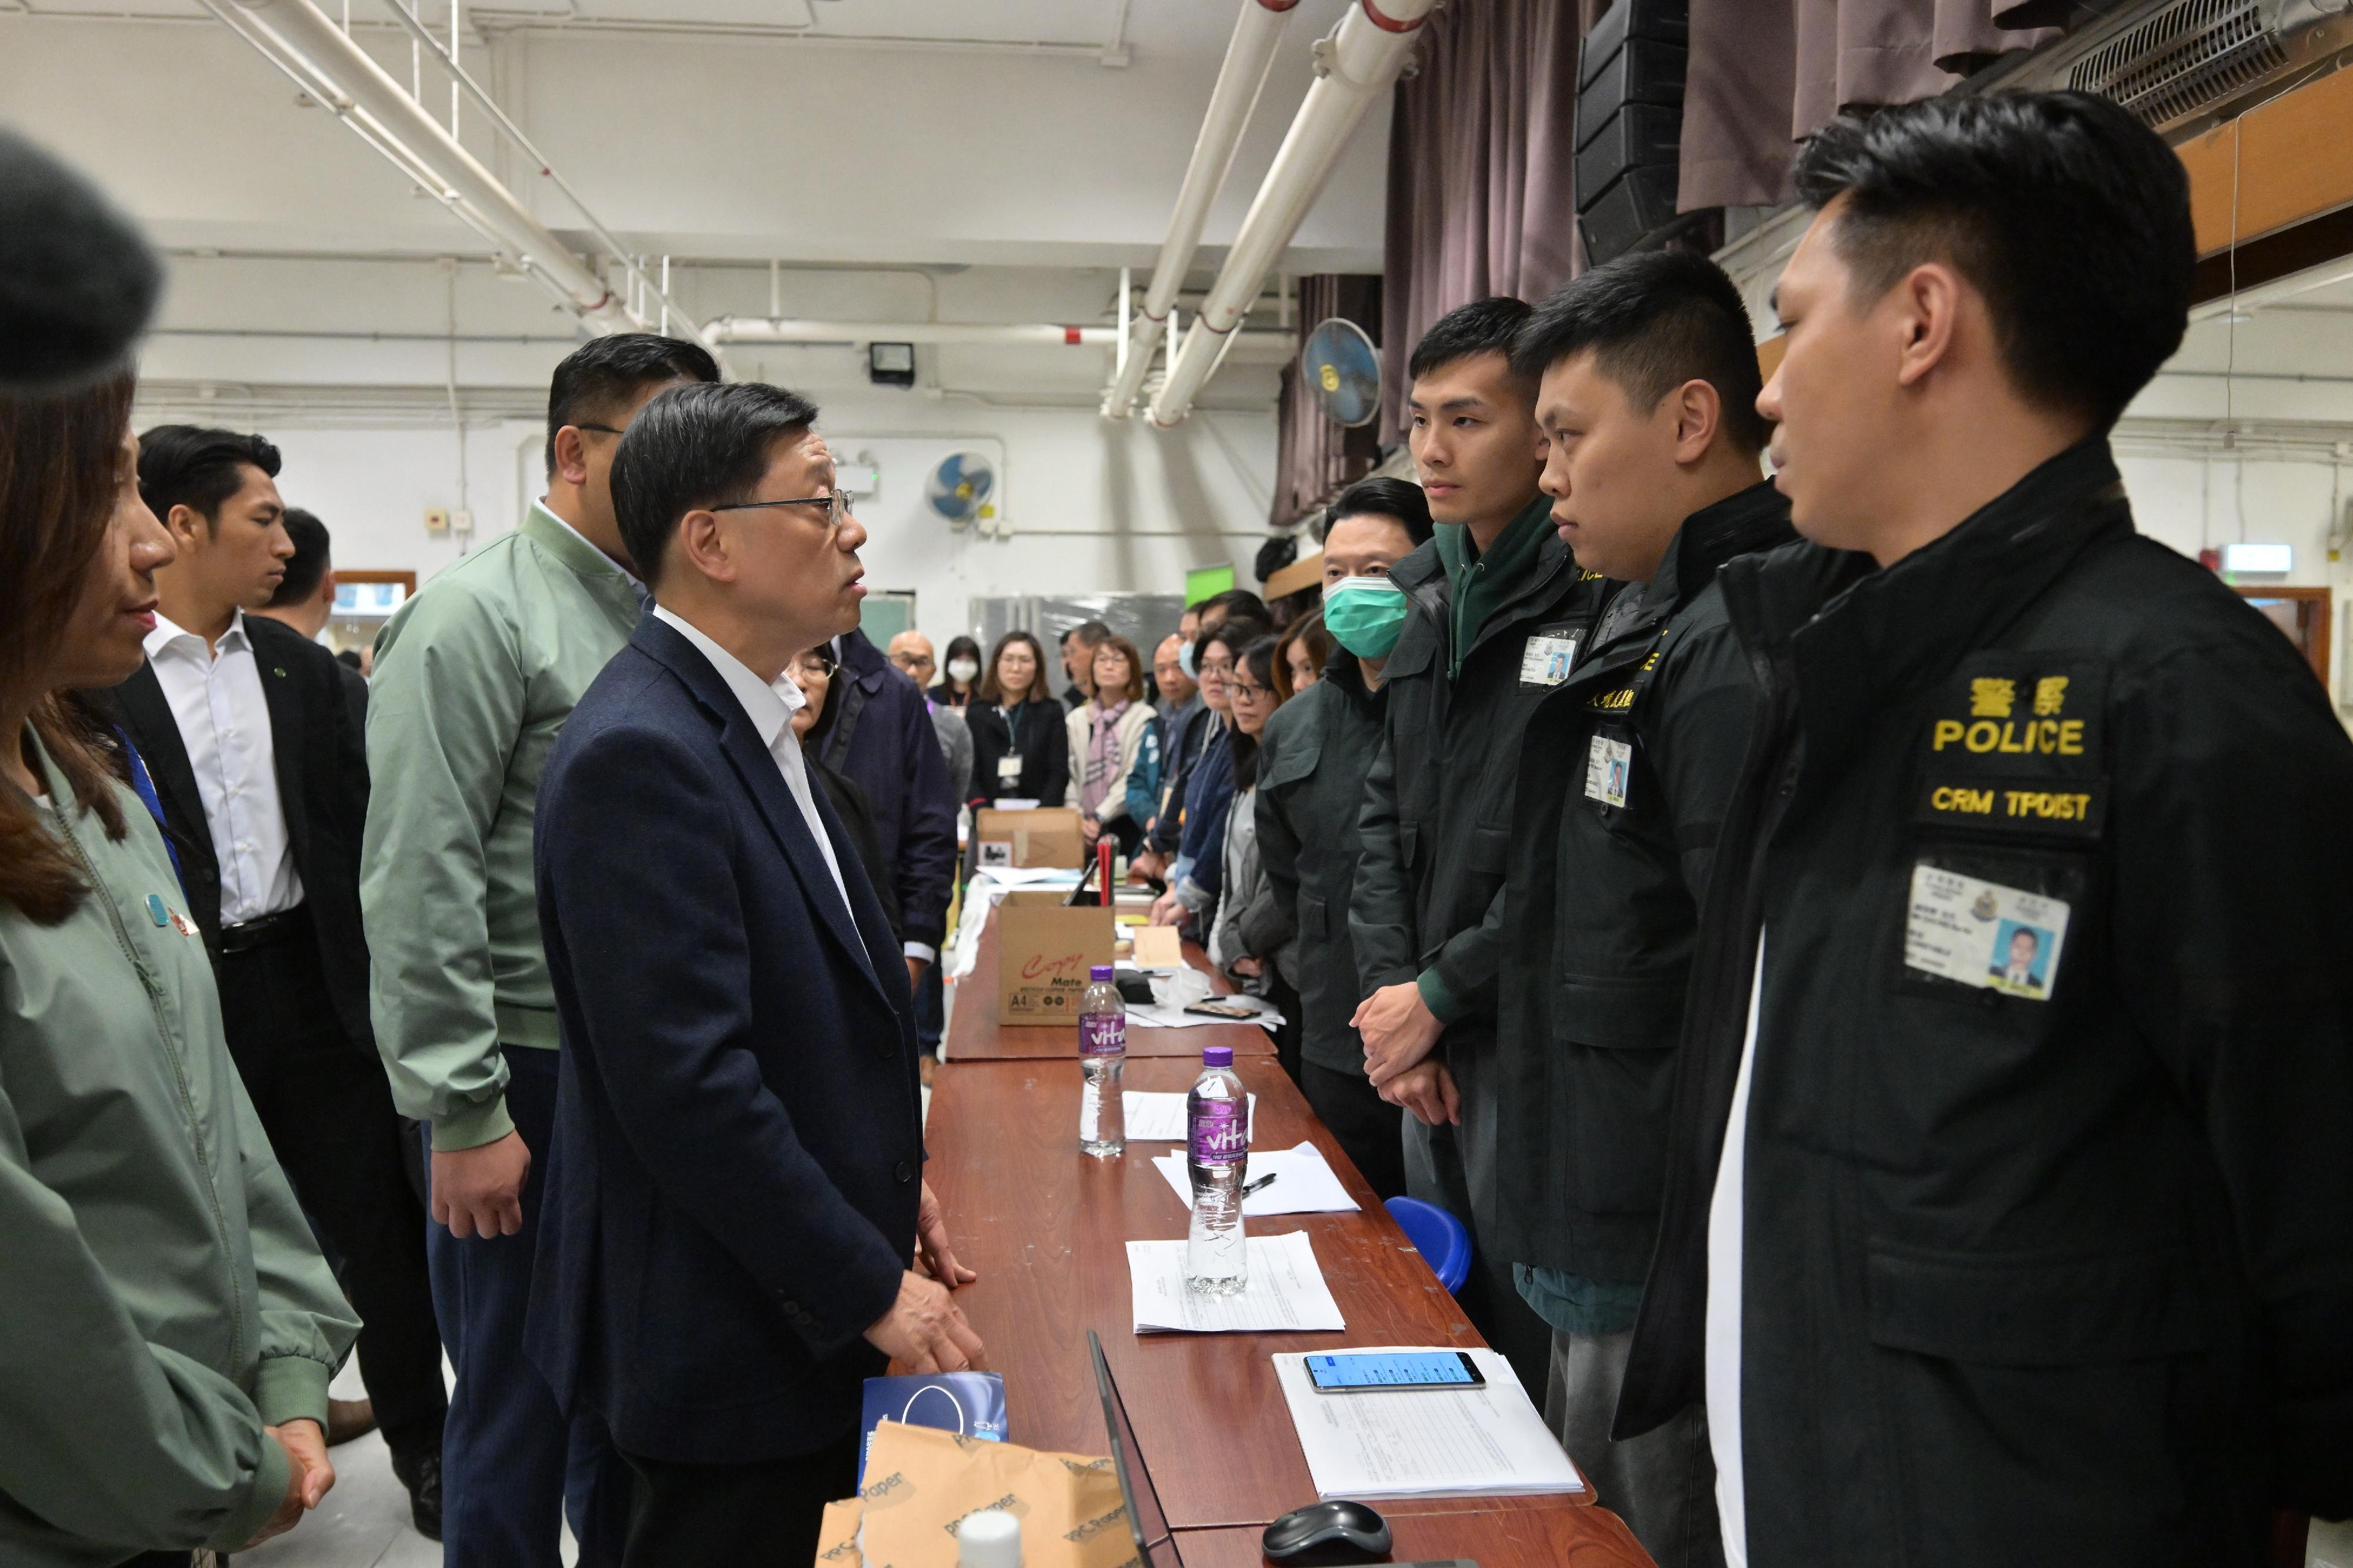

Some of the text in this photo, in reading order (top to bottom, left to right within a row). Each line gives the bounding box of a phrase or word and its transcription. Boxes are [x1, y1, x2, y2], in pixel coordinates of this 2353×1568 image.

[1933, 719, 2085, 755] POLICE
[1932, 787, 1994, 815] CRM
[1022, 953, 1083, 979] Copy
[1051, 977, 1082, 986] Mate
[1011, 995, 1026, 1007] A4
[860, 1471, 902, 1502] Paper
